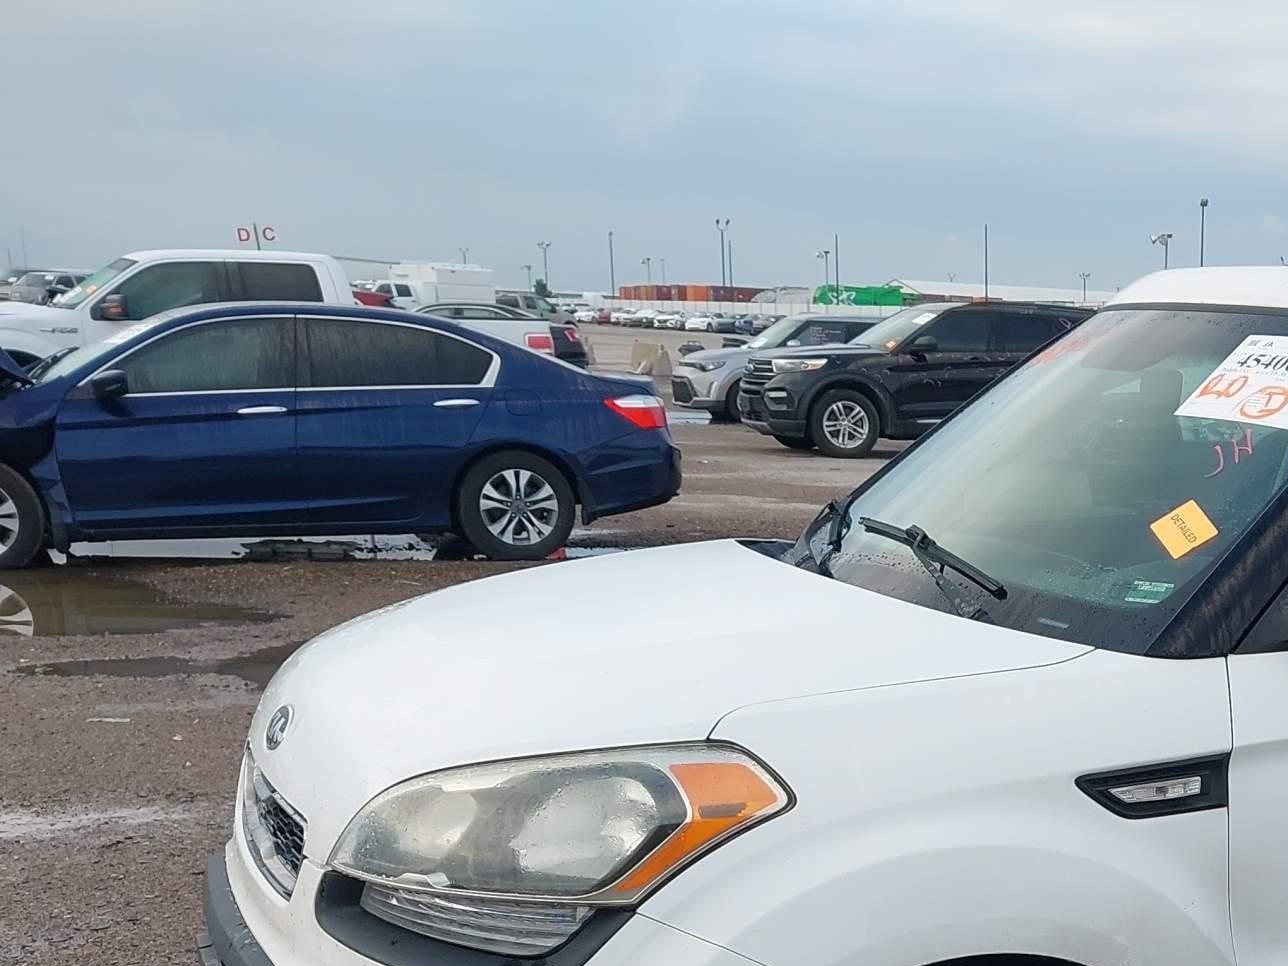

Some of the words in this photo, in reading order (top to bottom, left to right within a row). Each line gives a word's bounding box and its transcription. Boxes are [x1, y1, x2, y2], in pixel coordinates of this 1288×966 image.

[237, 227, 250, 242] D
[262, 226, 275, 241] C
[1170, 513, 1198, 544] DETAILED
